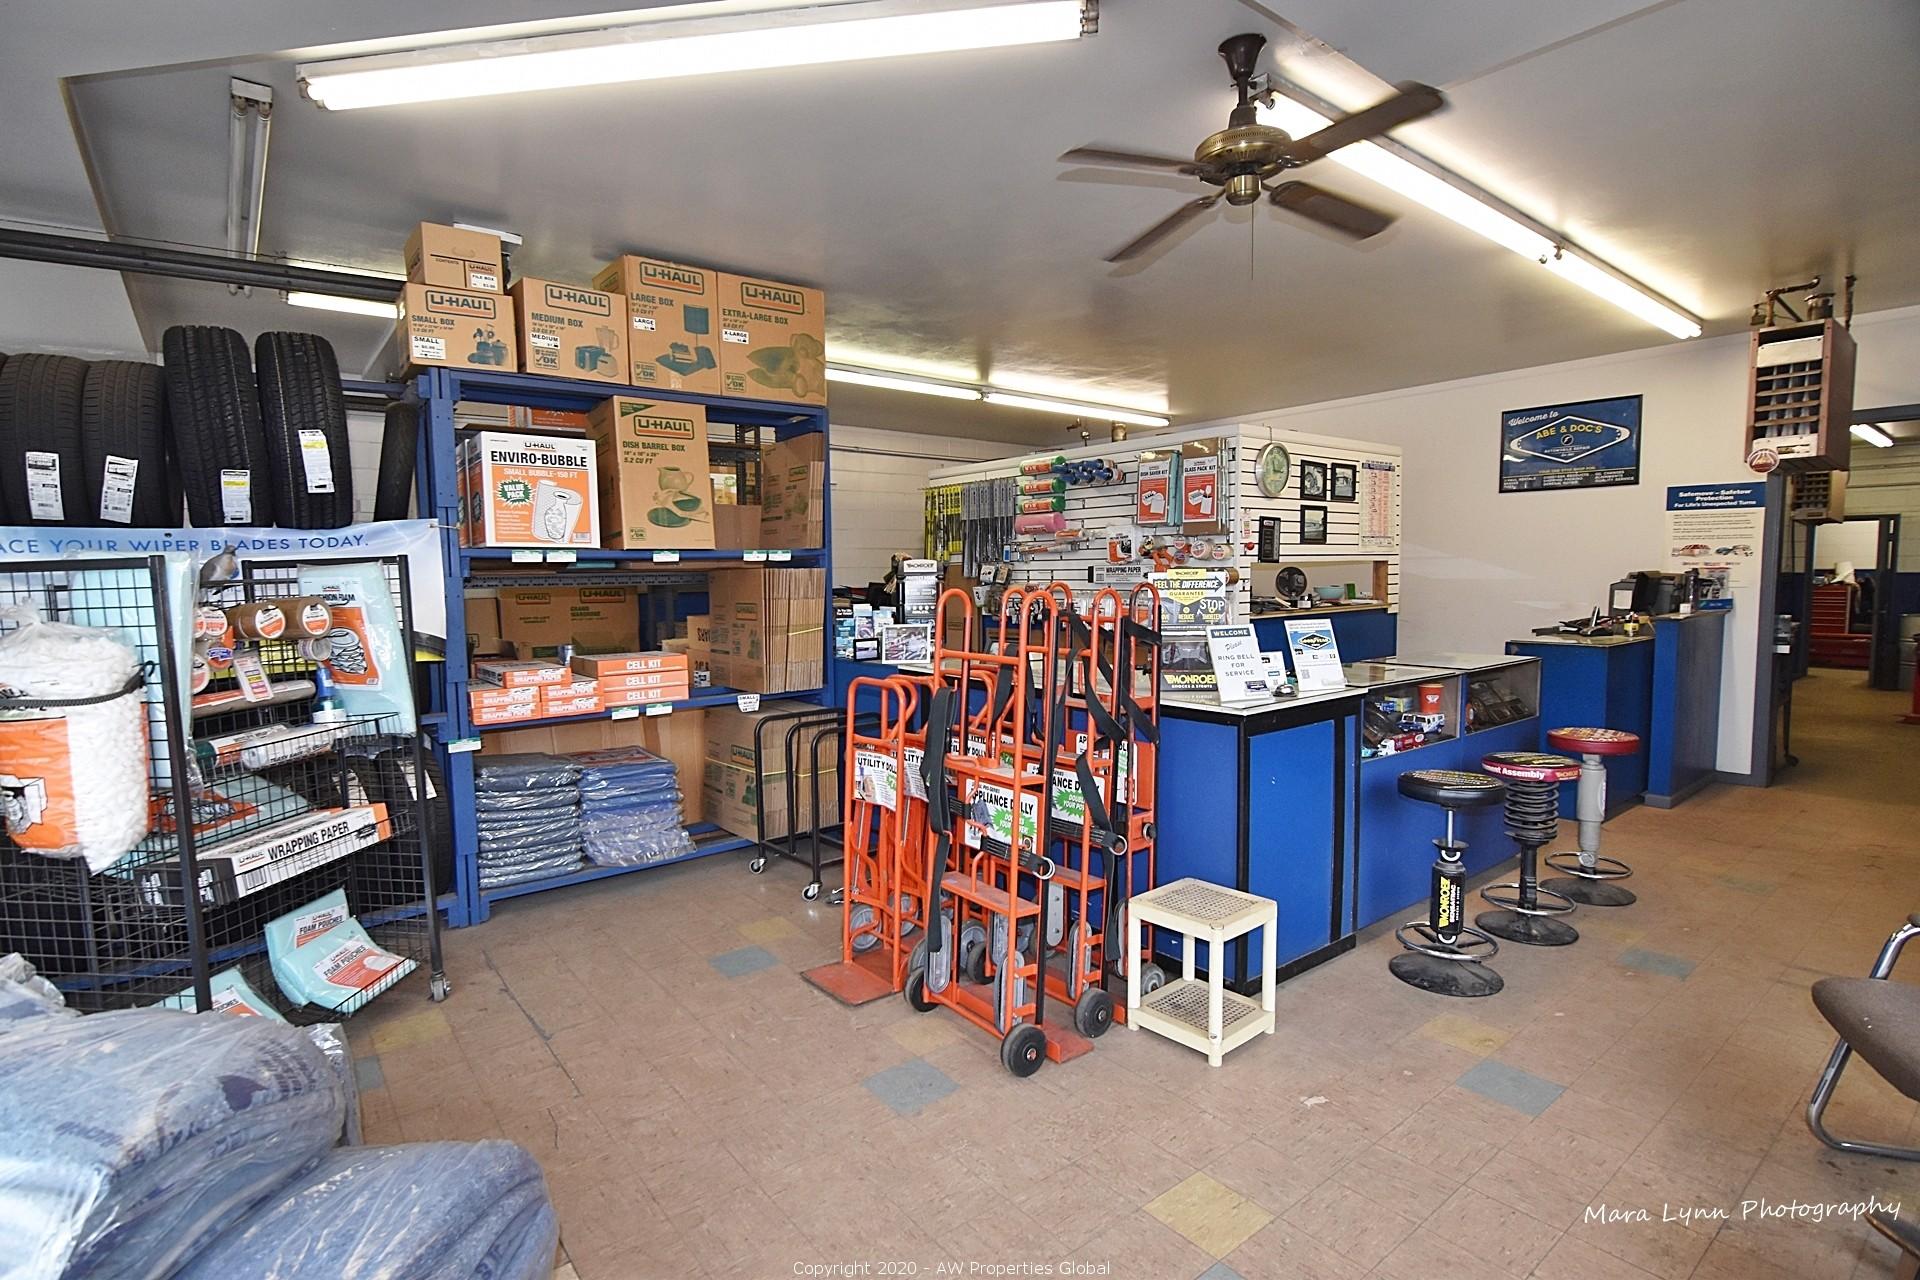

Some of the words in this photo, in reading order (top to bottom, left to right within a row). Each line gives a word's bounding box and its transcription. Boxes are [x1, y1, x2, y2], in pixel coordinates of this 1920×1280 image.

[643, 266, 701, 286] U-HAUL
[550, 288, 607, 308] U-HAUL
[630, 292, 657, 304] LARGE
[658, 297, 675, 307] BOX
[745, 286, 801, 305] U-HAUL
[430, 294, 492, 311] U-HAUL
[411, 314, 438, 325] SMALL
[440, 318, 455, 326] BOX
[531, 312, 565, 326] MEDIUM
[567, 318, 584, 328] BOX
[634, 317, 654, 326] LARGE
[722, 308, 772, 323] EXTRA-LARGE
[774, 316, 789, 325] BOX
[414, 335, 440, 345] SMALL
[531, 333, 559, 342] MEDIUM
[724, 330, 747, 338] X-LARGE
[637, 418, 690, 432] U-HAUL
[1508, 413, 1548, 426] Welcome
[1536, 427, 1556, 440] ABE
[1569, 424, 1603, 433] DOC'S
[524, 442, 556, 450] U-HAUL
[622, 441, 640, 449] DISH
[641, 442, 670, 451] BARREL
[671, 444, 686, 452] BOX
[490, 450, 588, 468] ENVIRO-BUBBLE
[503, 467, 528, 476] SMALL
[569, 471, 578, 479] FT
[503, 483, 525, 491] VALUE
[506, 490, 525, 499] PACK
[51, 539, 118, 553] YOUR
[128, 538, 200, 553] WIPER
[210, 538, 290, 551] BLADES
[298, 534, 370, 550] TODAY.
[1154, 580, 1168, 589] FEEL
[1169, 580, 1181, 588] THE
[1181, 579, 1220, 589] DIFFERENCE
[582, 589, 623, 599] U-HAUL
[1200, 599, 1225, 610] STOP
[1213, 629, 1249, 637] WELCOME
[626, 660, 646, 670] CELL
[648, 660, 663, 669] KIT
[626, 675, 646, 686] CELL
[648, 675, 663, 685] KIT
[1168, 674, 1217, 684] MONROE
[626, 690, 646, 702] CELL
[648, 689, 663, 701] KIT
[857, 757, 886, 770] UTILITY
[1501, 766, 1546, 780] Assembly
[267, 833, 320, 861] WRAPPING
[320, 821, 350, 841] PAPER
[239, 851, 264, 865] U-HAUL
[1439, 877, 1451, 927] MONROE
[299, 921, 318, 935] FOAM
[317, 915, 344, 930] POUCHES
[323, 963, 342, 978] FOAM
[340, 944, 368, 966] POUCHES
